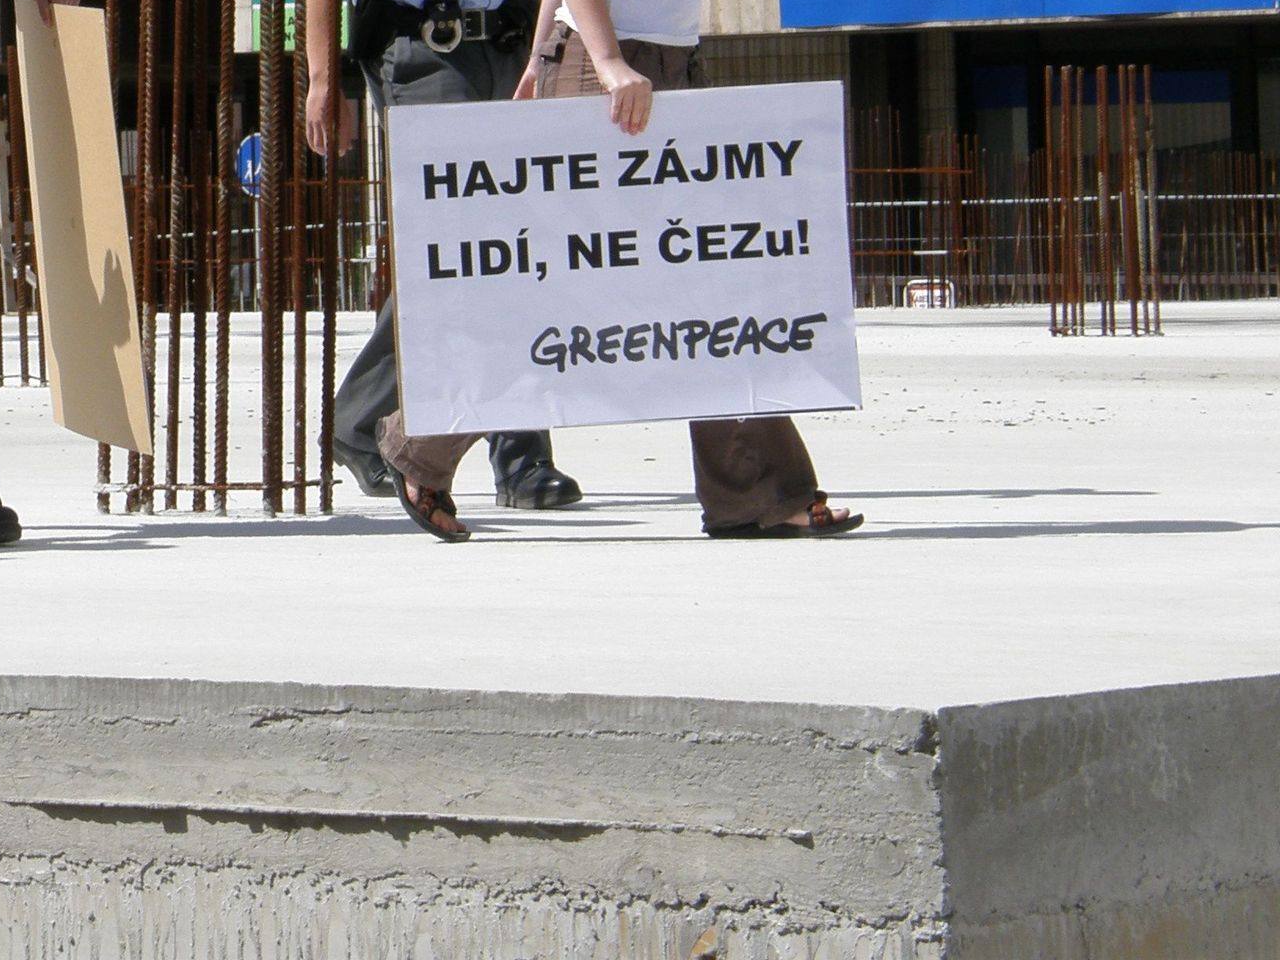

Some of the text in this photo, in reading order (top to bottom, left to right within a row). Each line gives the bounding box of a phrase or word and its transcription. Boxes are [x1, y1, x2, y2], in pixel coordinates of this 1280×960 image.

[423, 138, 804, 200] HAJTE ZÁJMY
[427, 218, 811, 282] LIDÍ, NE ČEZu!
[530, 313, 827, 373] GREENPEACE
